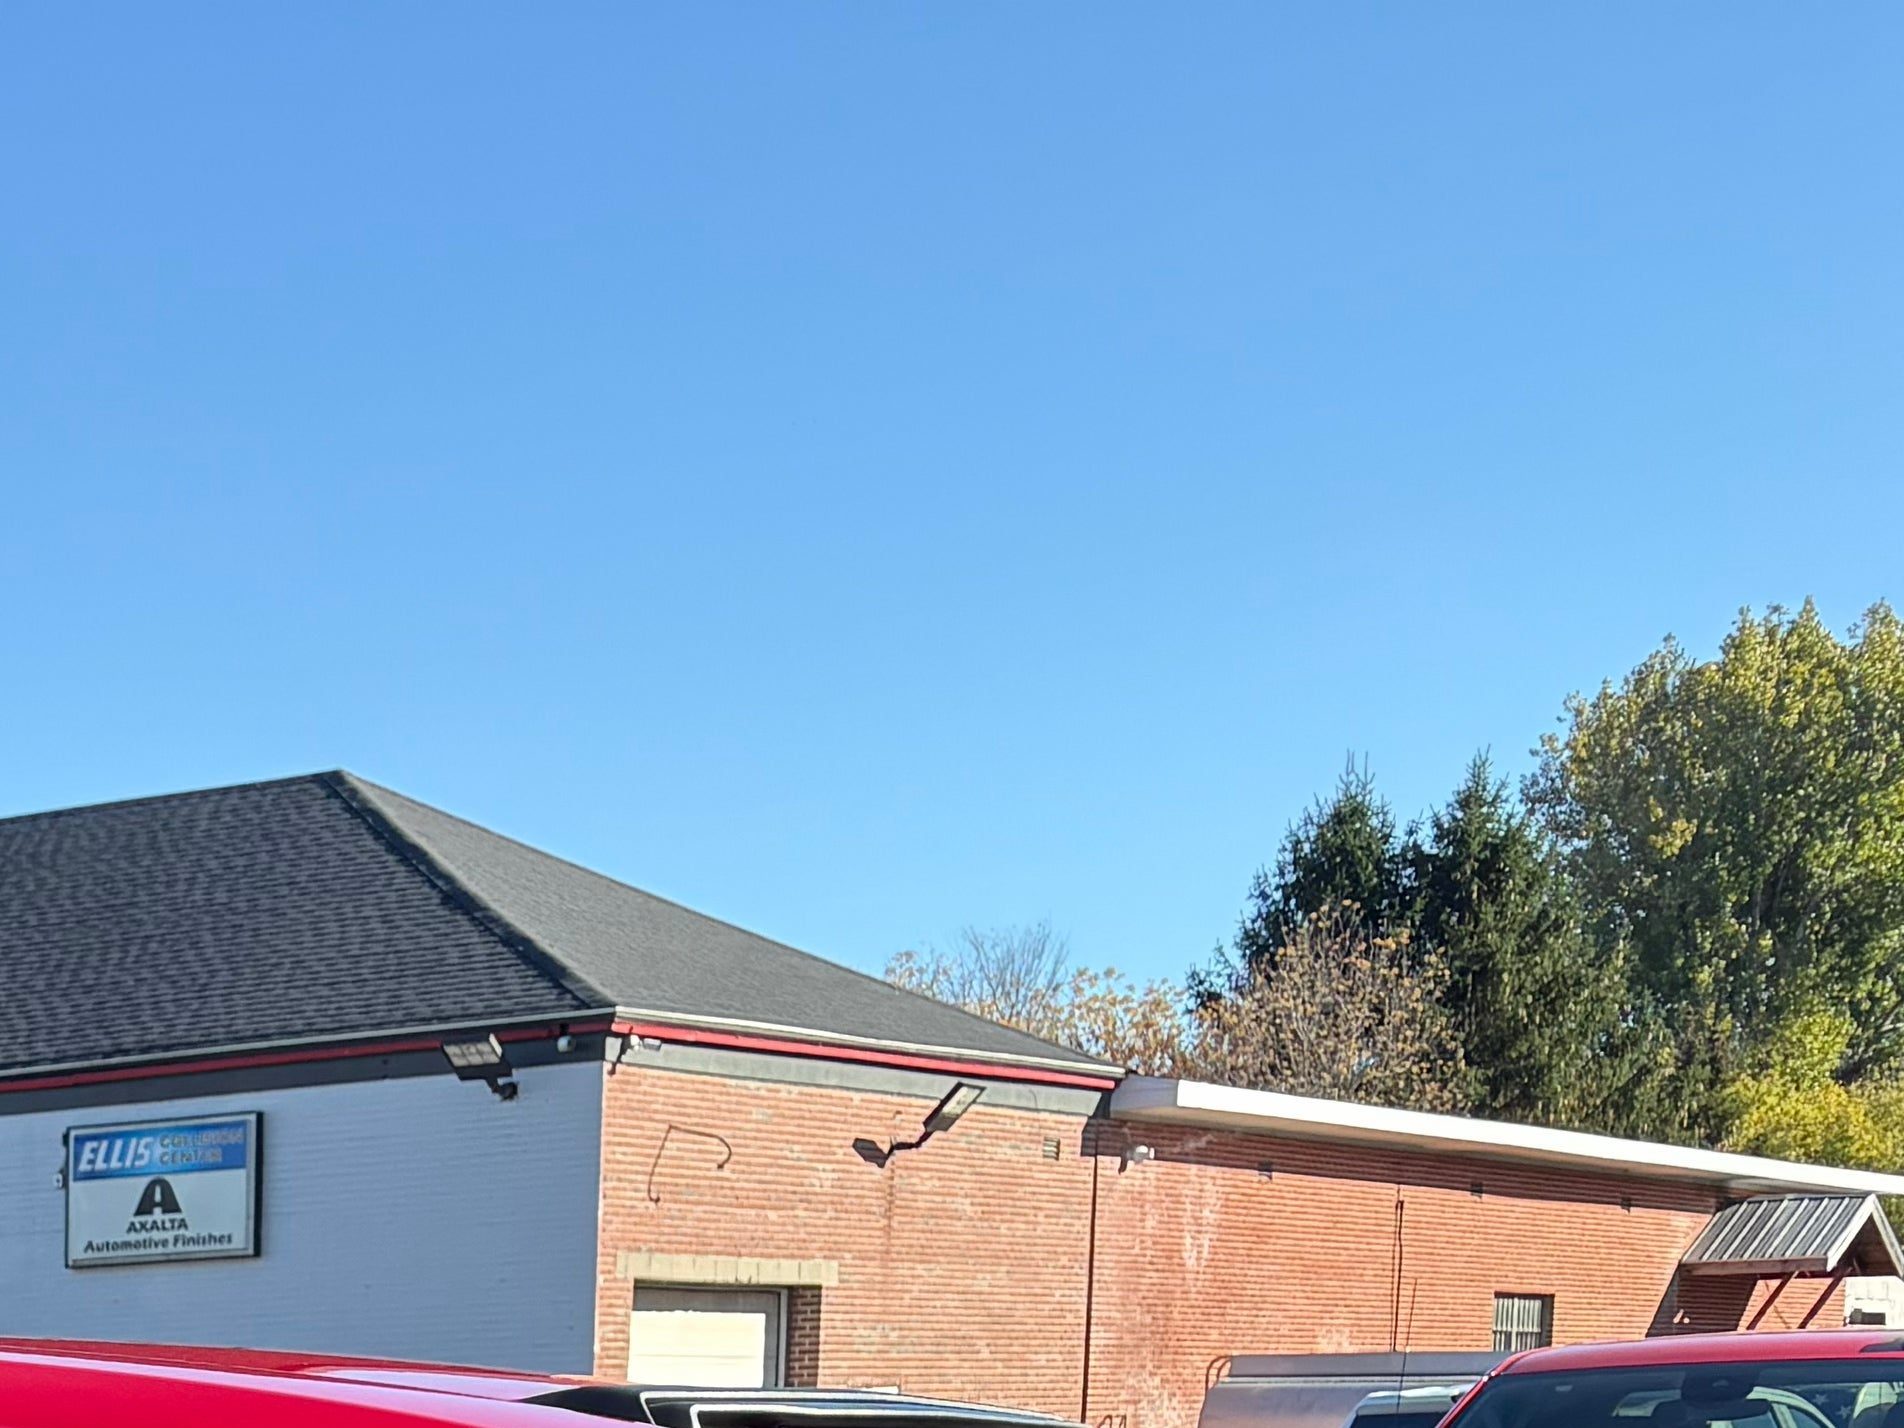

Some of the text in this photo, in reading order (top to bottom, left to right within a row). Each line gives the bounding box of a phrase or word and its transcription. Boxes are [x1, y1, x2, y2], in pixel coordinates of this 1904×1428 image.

[78, 1137, 155, 1172] ELLIS
[126, 1217, 189, 1235] AXALTA
[84, 1232, 234, 1254] Automotive Finishes
